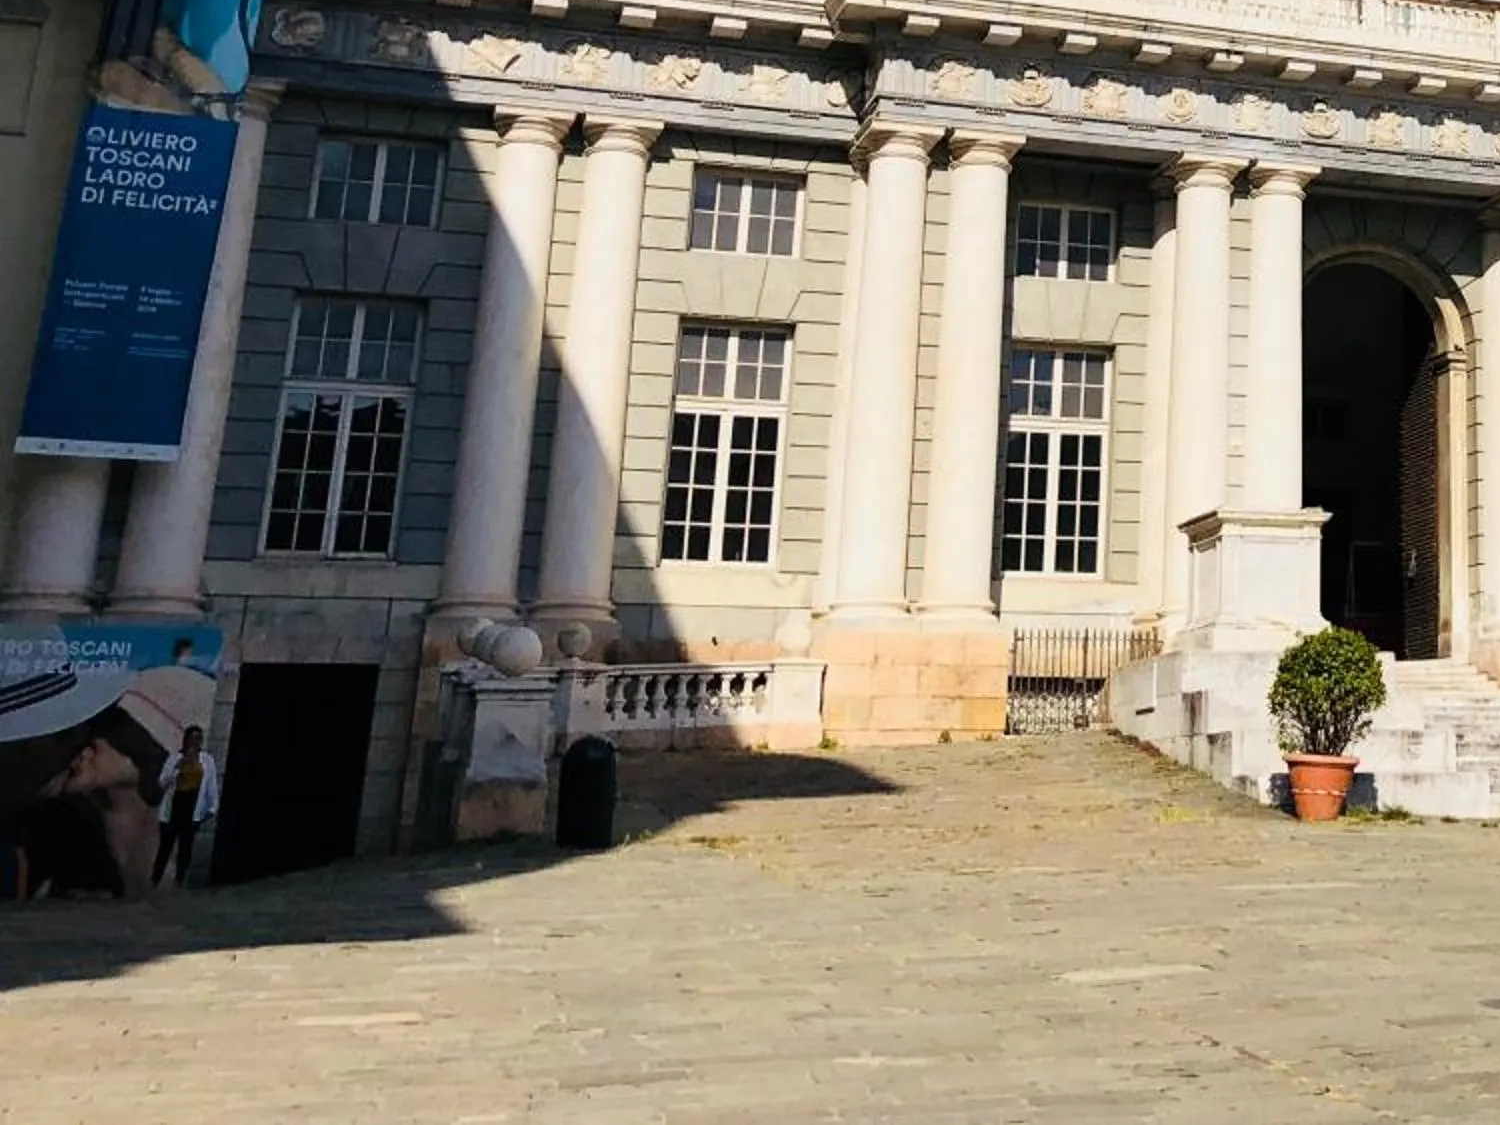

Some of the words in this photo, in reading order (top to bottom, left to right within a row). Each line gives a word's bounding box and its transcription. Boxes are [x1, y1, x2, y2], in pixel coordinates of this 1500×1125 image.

[86, 126, 198, 152] OLIVIERO
[86, 146, 192, 172] TOSCANI
[84, 165, 165, 189] LADRO
[81, 186, 105, 204] DI
[41, 640, 132, 657] TOSCANI
